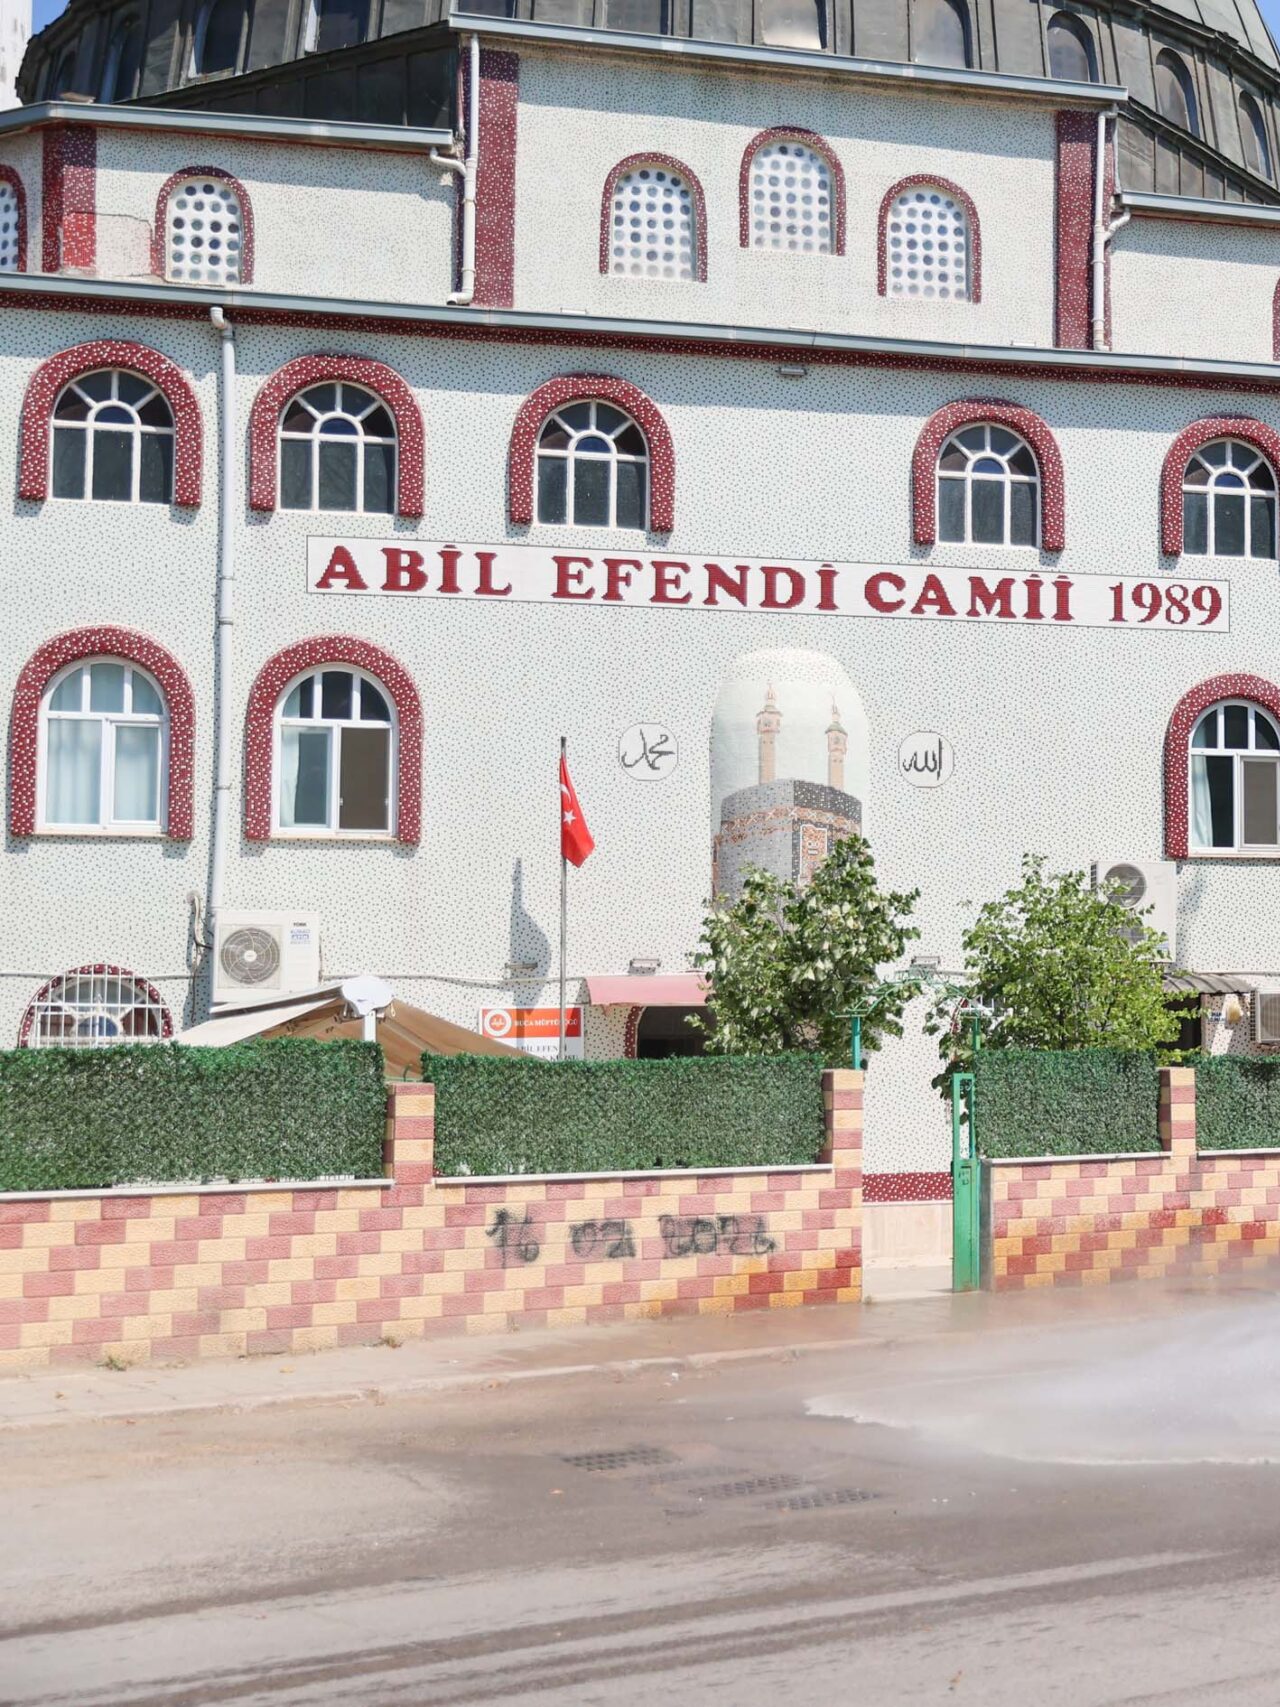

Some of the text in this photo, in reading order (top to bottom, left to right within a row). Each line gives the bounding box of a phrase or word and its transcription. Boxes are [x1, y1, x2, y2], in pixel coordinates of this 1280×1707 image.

[315, 544, 1223, 626] ABİL EFENDİ CAMİİ 1989
[902, 737, 944, 781] الله
